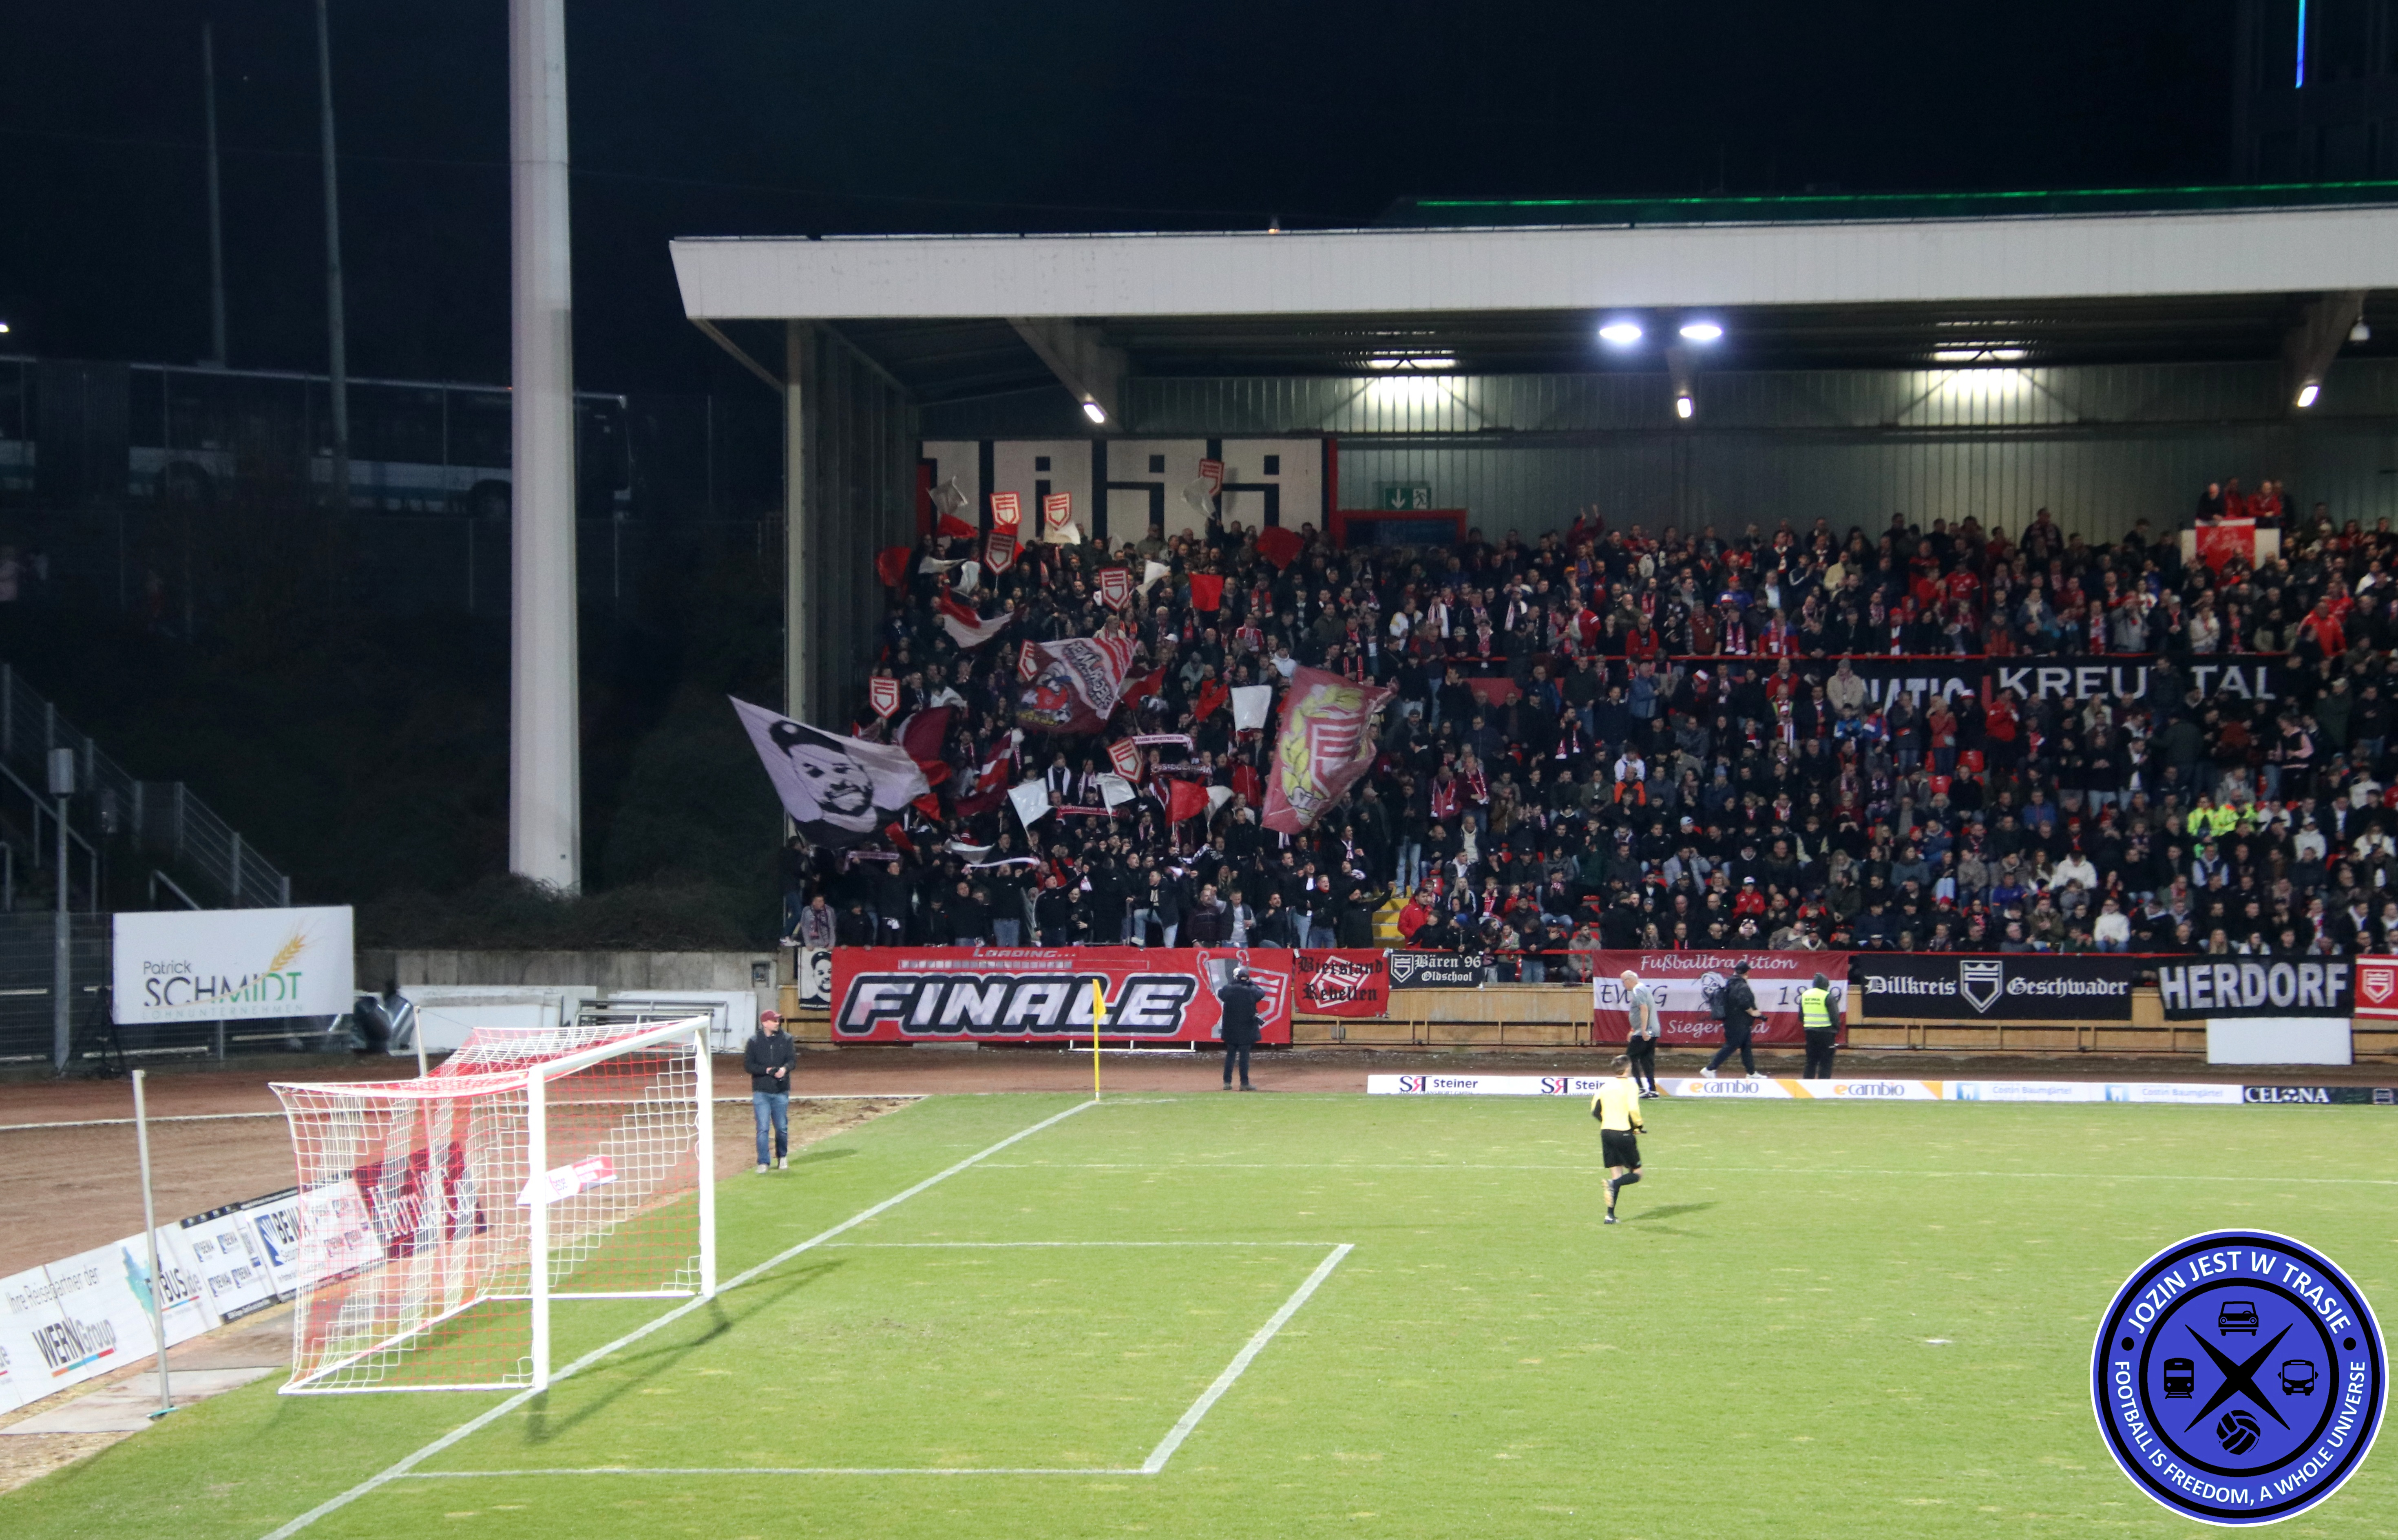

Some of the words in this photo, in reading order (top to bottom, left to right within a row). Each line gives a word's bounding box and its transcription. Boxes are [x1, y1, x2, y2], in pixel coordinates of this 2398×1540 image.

[1999, 666, 2276, 700] KREUTAL
[144, 960, 191, 974] Patrick
[1298, 957, 1383, 975] Bierstand
[1415, 954, 1458, 969] Bären
[1421, 971, 1472, 982] Oldschool
[1864, 976, 1956, 995] Dillkreis
[2159, 963, 2348, 1009] HERDORF
[144, 972, 302, 1007] SCHMIDT
[1303, 982, 1378, 1001] Rebellen
[1600, 984, 1668, 1007] EWG
[1778, 986, 1841, 1005] 189
[2007, 977, 2128, 998] Geschwader
[142, 1004, 303, 1020] LOHNUNTERNEHMEN
[839, 976, 1196, 1032] FINALE
[1667, 1020, 1770, 1038] Siegerd
[1434, 1079, 1478, 1088] Steiner
[1576, 1081, 1605, 1090] Stein
[5, 1291, 29, 1315] Ihre
[23, 1273, 84, 1308] Reisepartner
[83, 1264, 99, 1286] der
